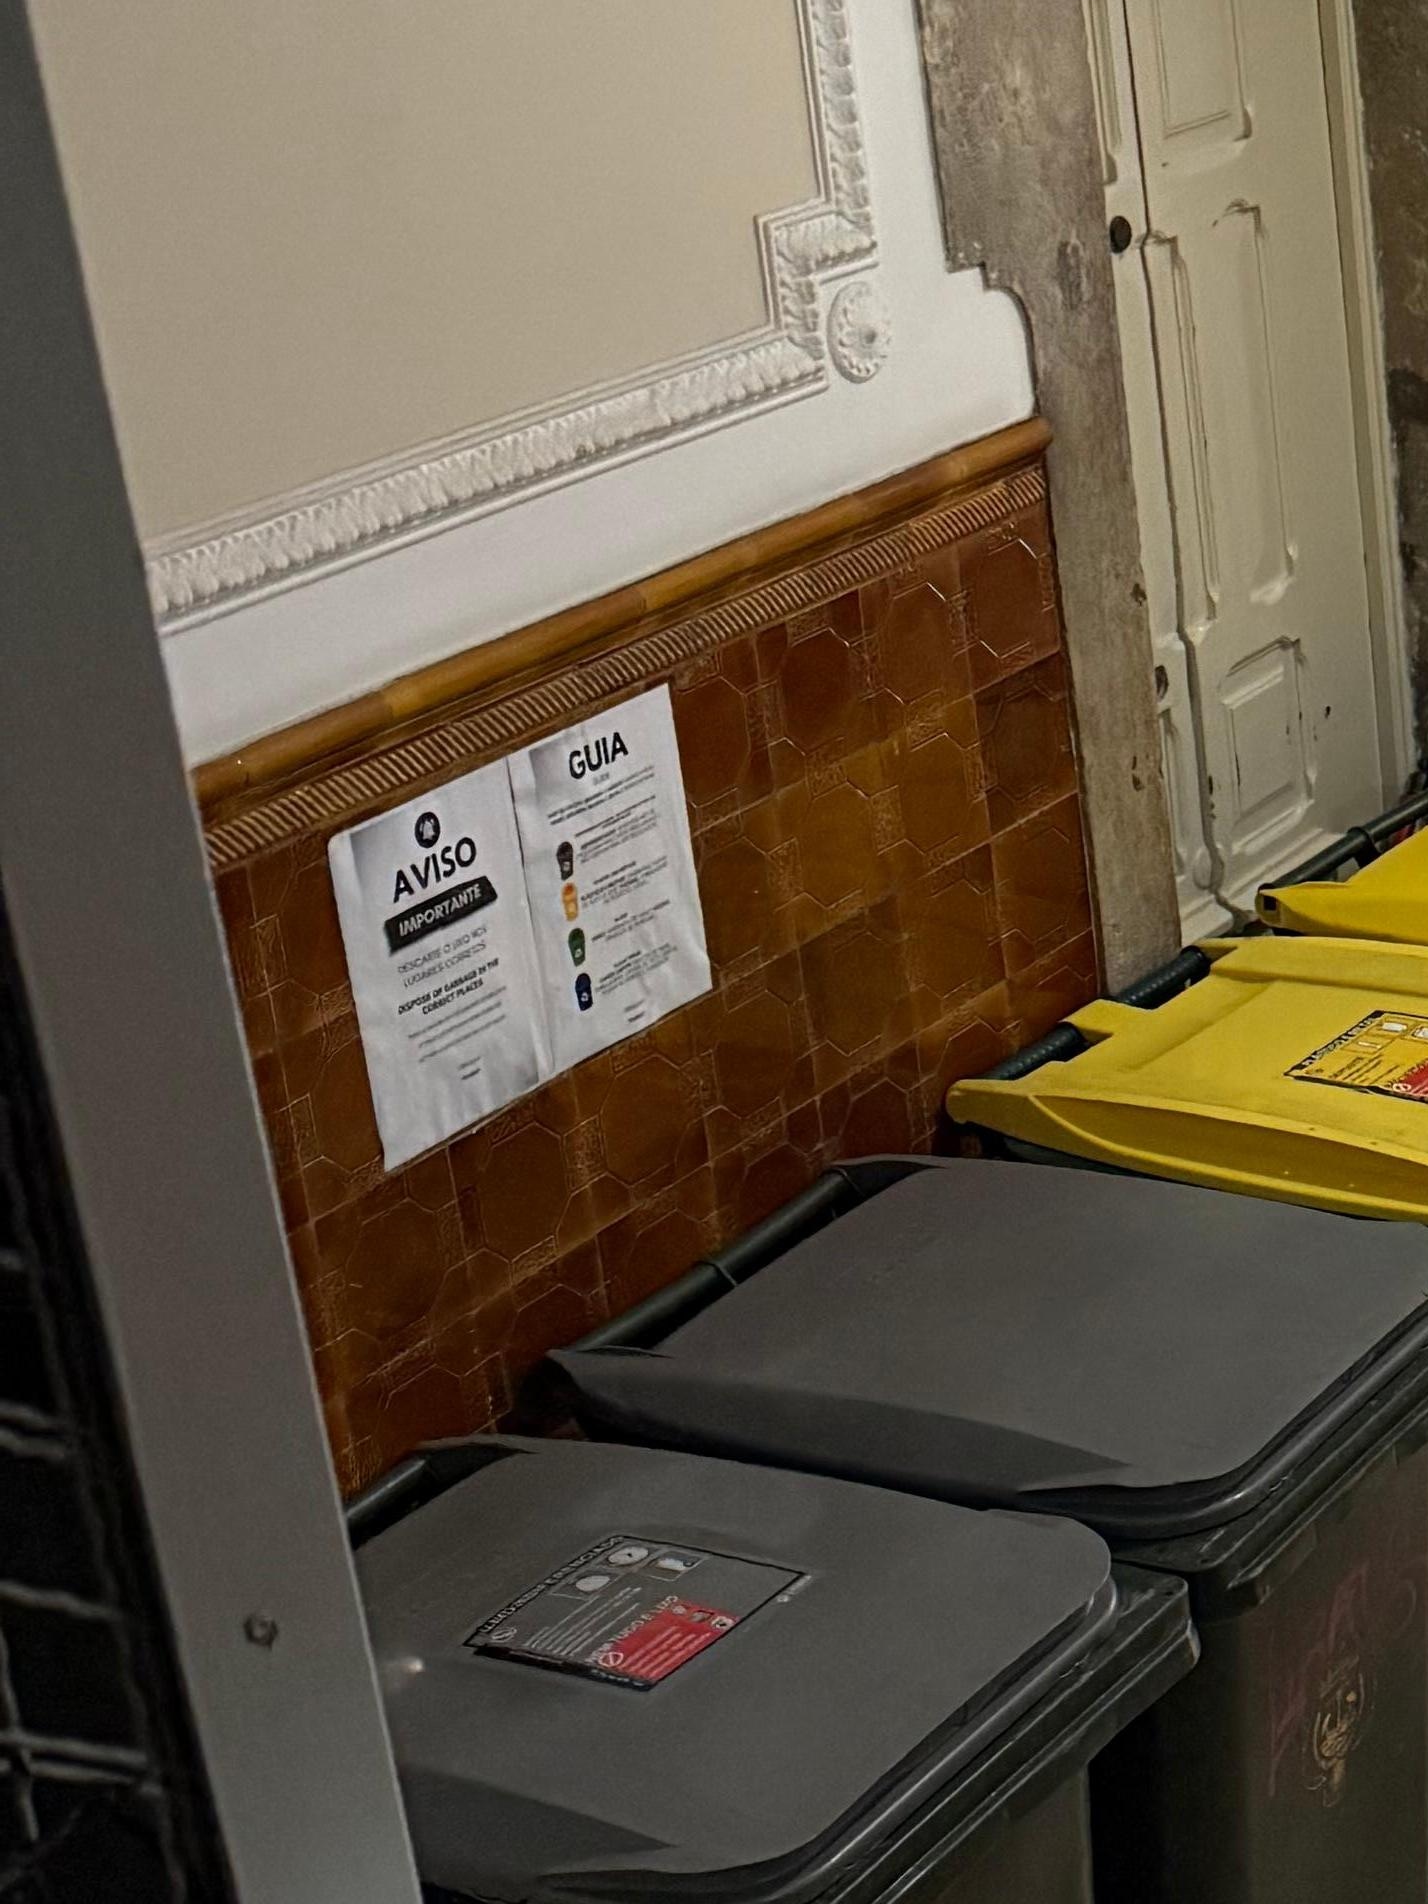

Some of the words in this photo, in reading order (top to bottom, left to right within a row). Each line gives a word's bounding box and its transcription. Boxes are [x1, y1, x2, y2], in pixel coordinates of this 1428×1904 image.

[568, 732, 629, 780] GUIA
[392, 836, 478, 903] AVISO
[398, 884, 484, 937] IMPORTANTE
